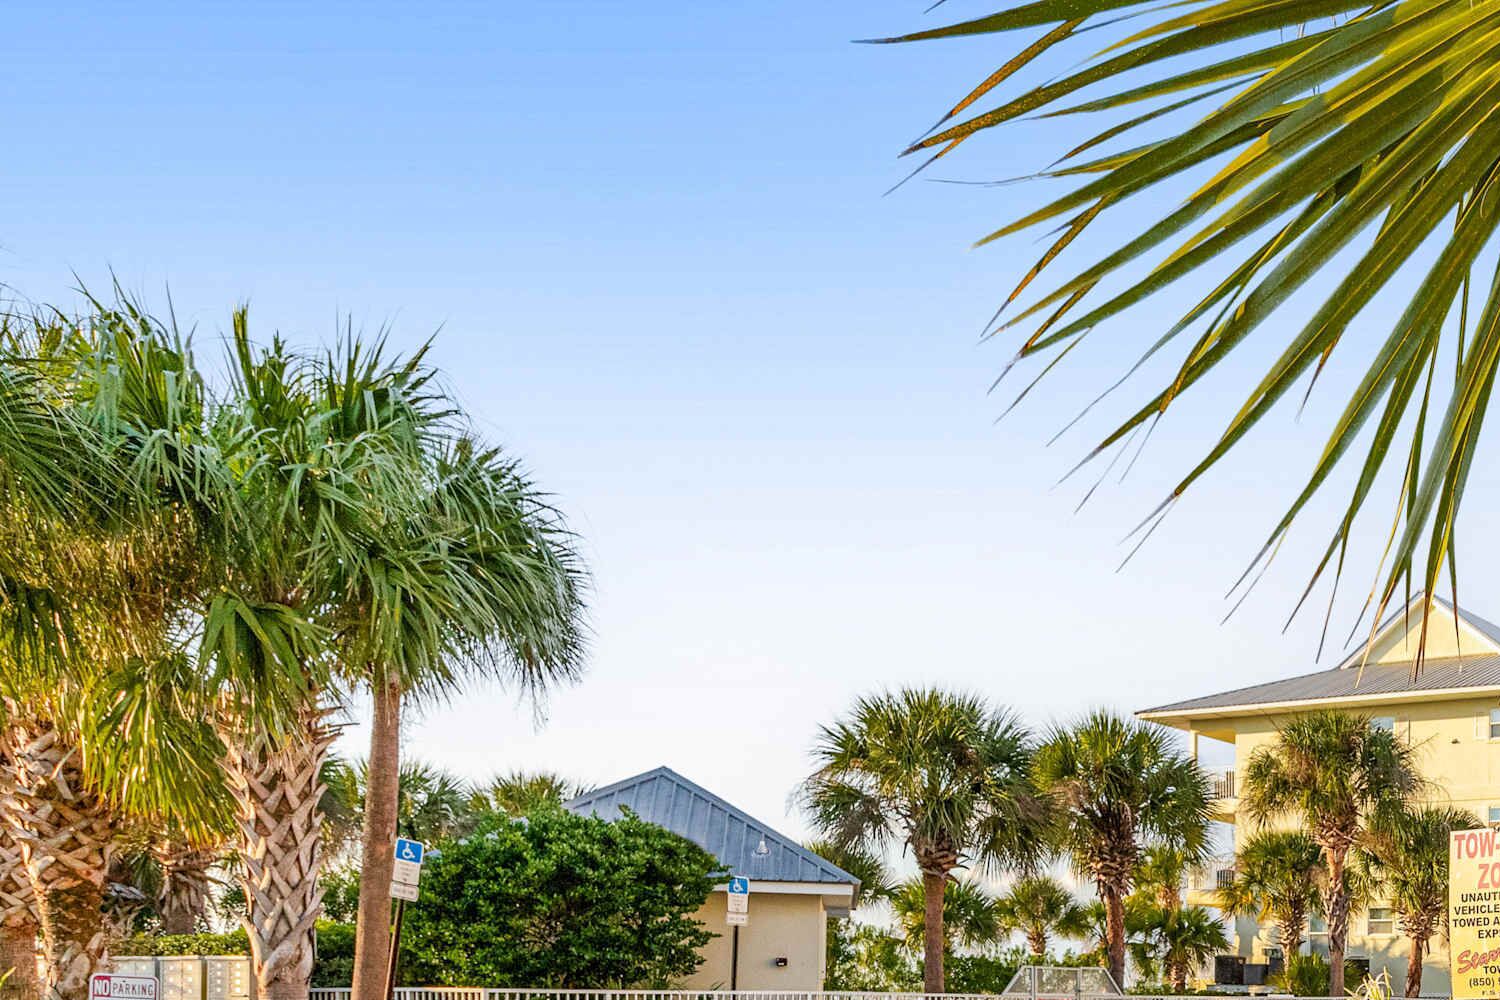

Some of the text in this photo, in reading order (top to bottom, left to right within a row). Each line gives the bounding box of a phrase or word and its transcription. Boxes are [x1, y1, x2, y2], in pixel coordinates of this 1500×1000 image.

[1453, 916, 1490, 928] TOWED
[95, 979, 154, 996] NO PARKING
[1469, 977, 1495, 988] (850)
